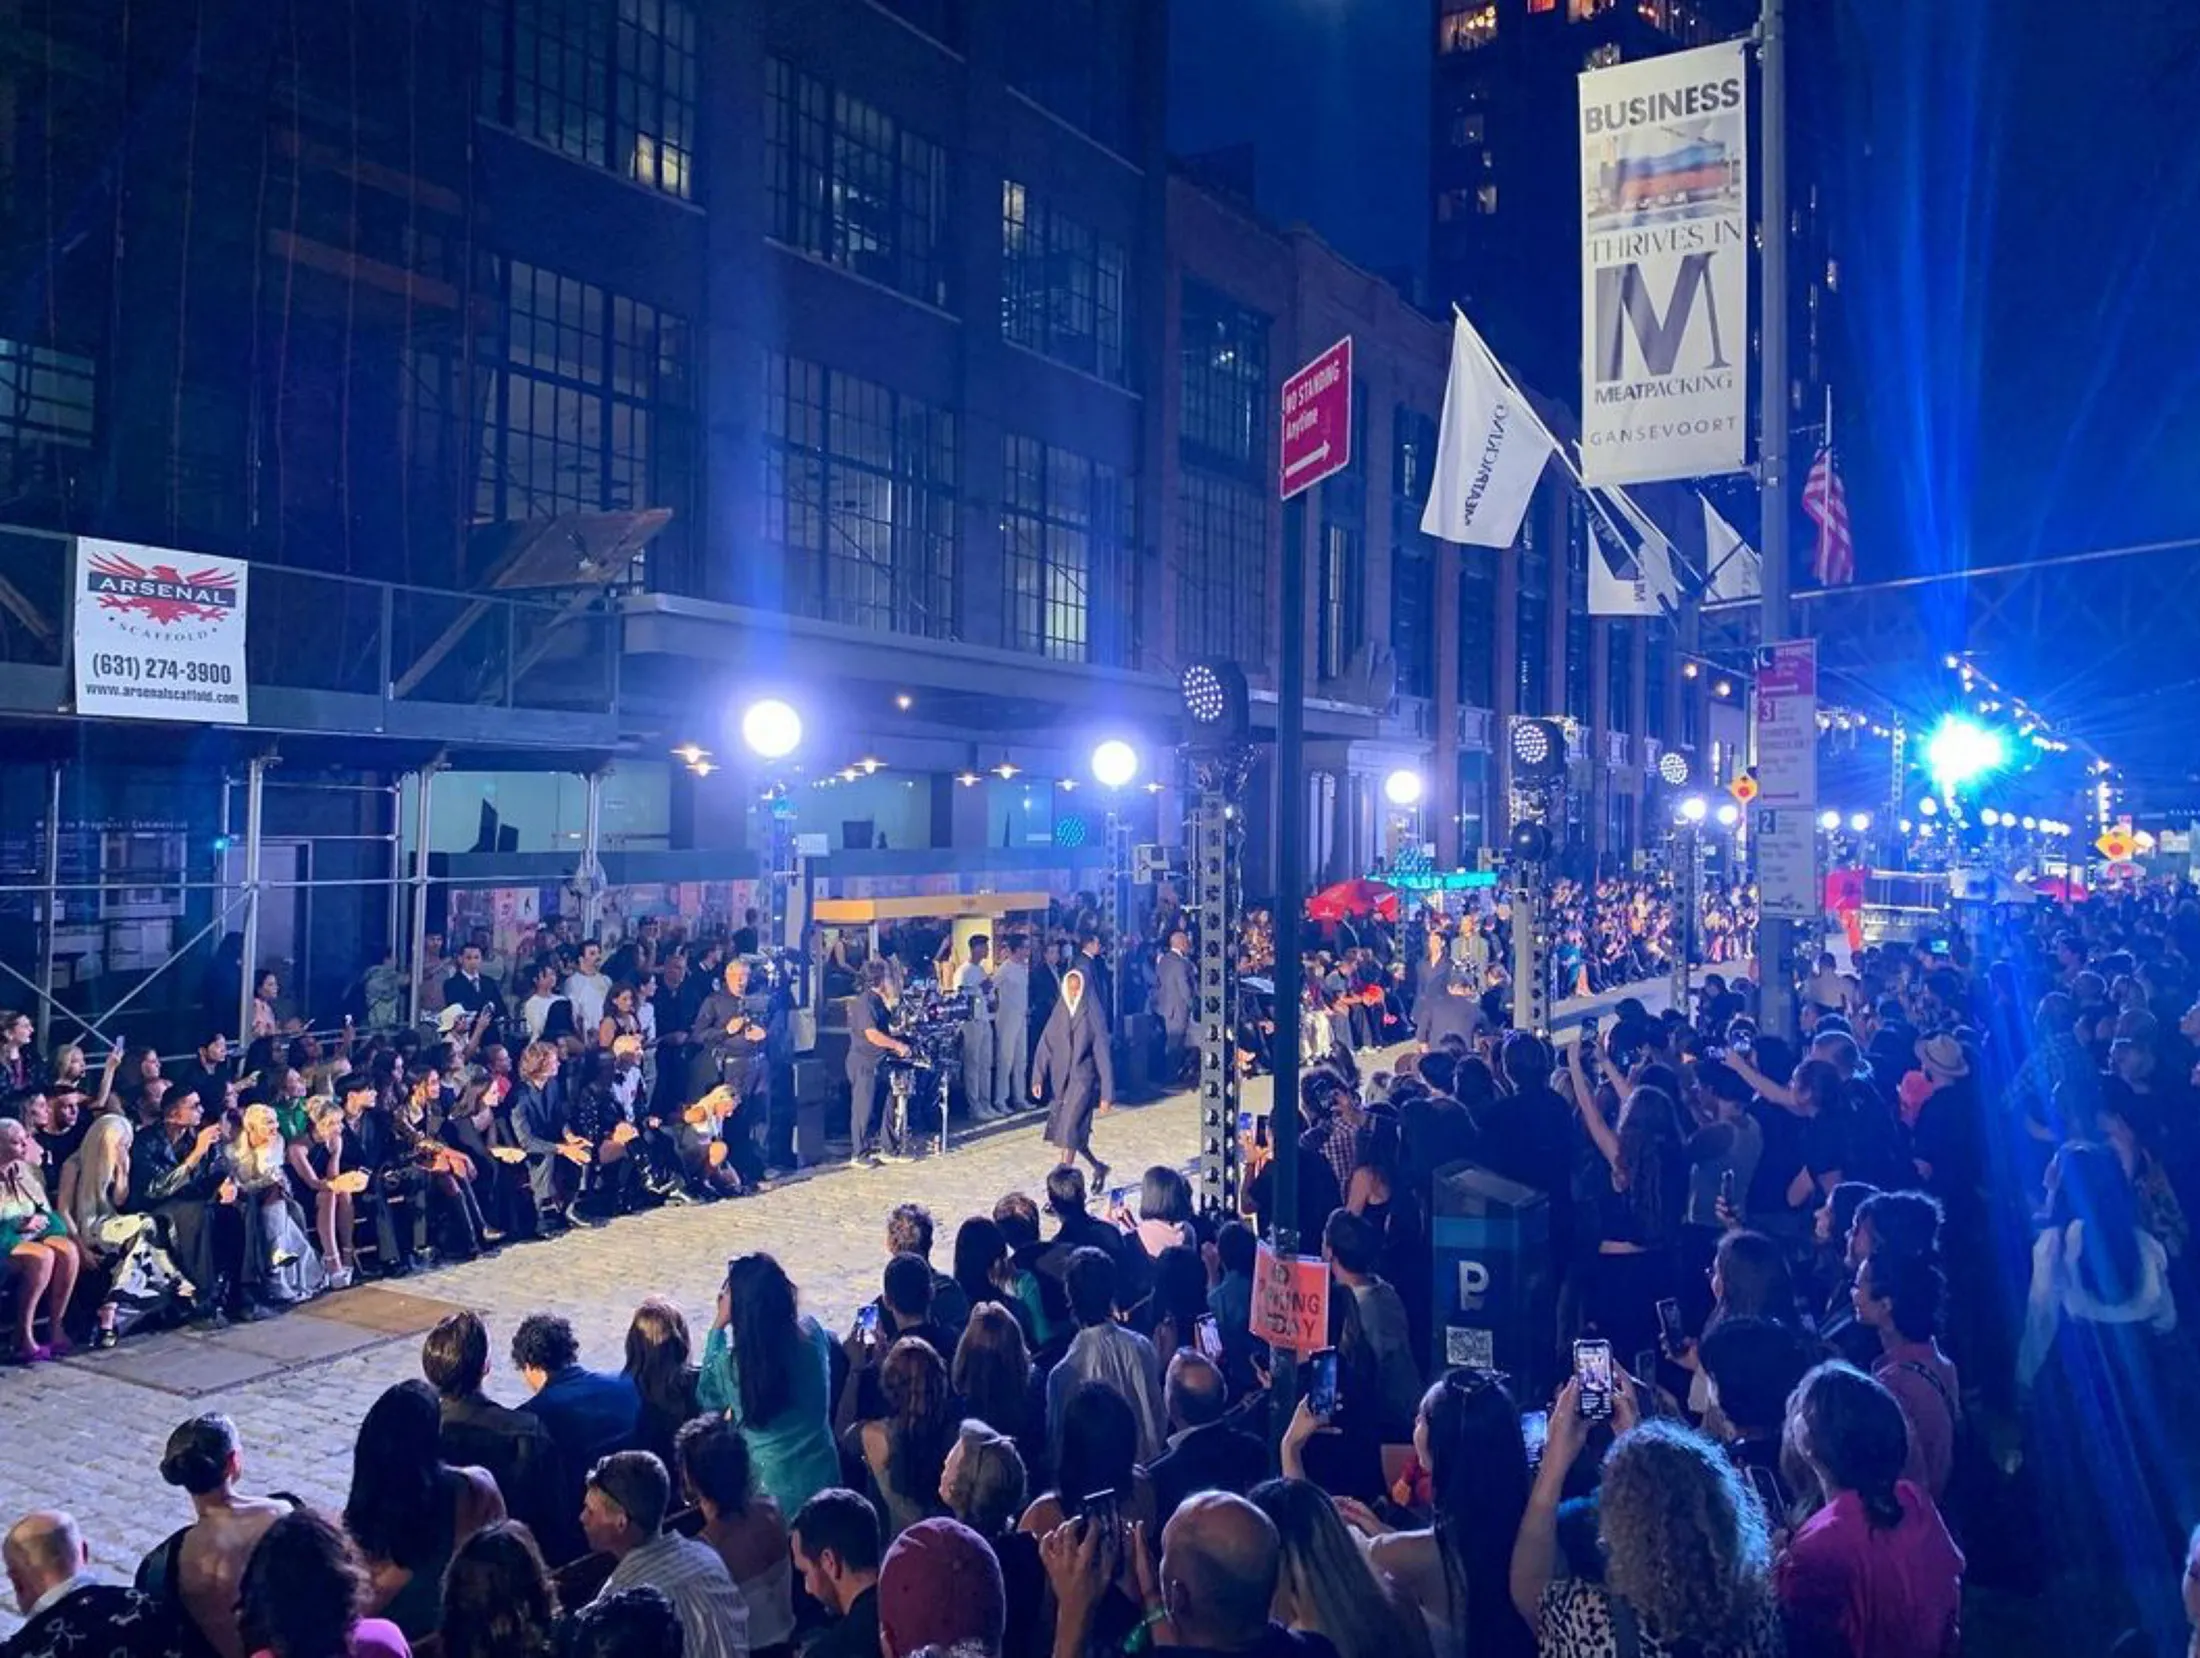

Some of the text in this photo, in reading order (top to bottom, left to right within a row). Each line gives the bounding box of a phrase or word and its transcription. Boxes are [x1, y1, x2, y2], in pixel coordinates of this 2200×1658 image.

[1585, 78, 1740, 133] BUSINESS
[1590, 219, 1741, 262] THRIVES IN
[1596, 251, 1732, 381] M
[1298, 360, 1340, 407] STANDING
[1595, 373, 1733, 405] MEATPACKING
[1590, 416, 1738, 446] GANSEVOORT
[99, 577, 228, 605] ARSENAL
[120, 622, 207, 640] SCAFFOLD
[93, 653, 231, 685] (631) 274-3900
[86, 683, 240, 704] www.arsenalscaffold.com
[1761, 700, 1772, 720] 3
[1762, 812, 1771, 832] 2
[1459, 1260, 1490, 1311] P
